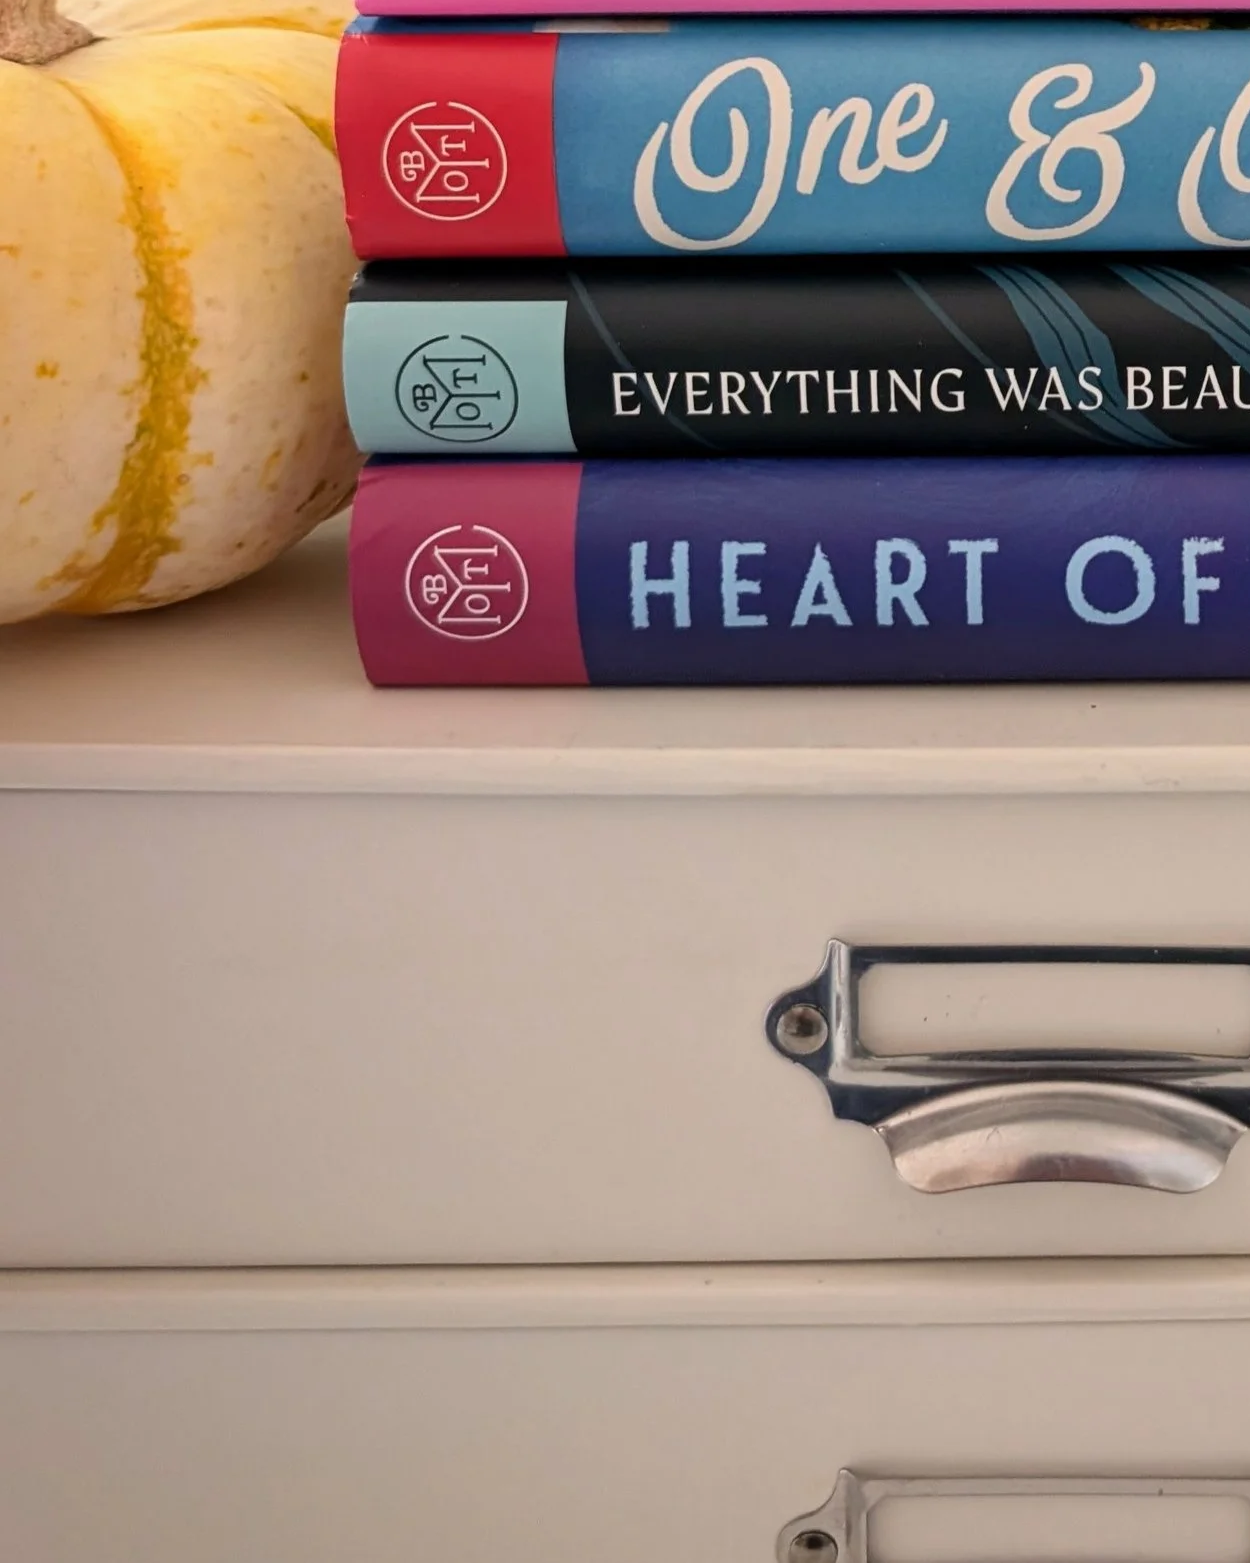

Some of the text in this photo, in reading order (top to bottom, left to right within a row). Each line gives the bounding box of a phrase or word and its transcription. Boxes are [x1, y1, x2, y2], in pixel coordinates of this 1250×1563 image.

[633, 56, 949, 251] One
[985, 61, 1156, 242] &
[611, 367, 966, 418] EVERYTHING
[984, 365, 1105, 413] WAS
[629, 537, 999, 629] HEART
[1064, 535, 1225, 626] OF
